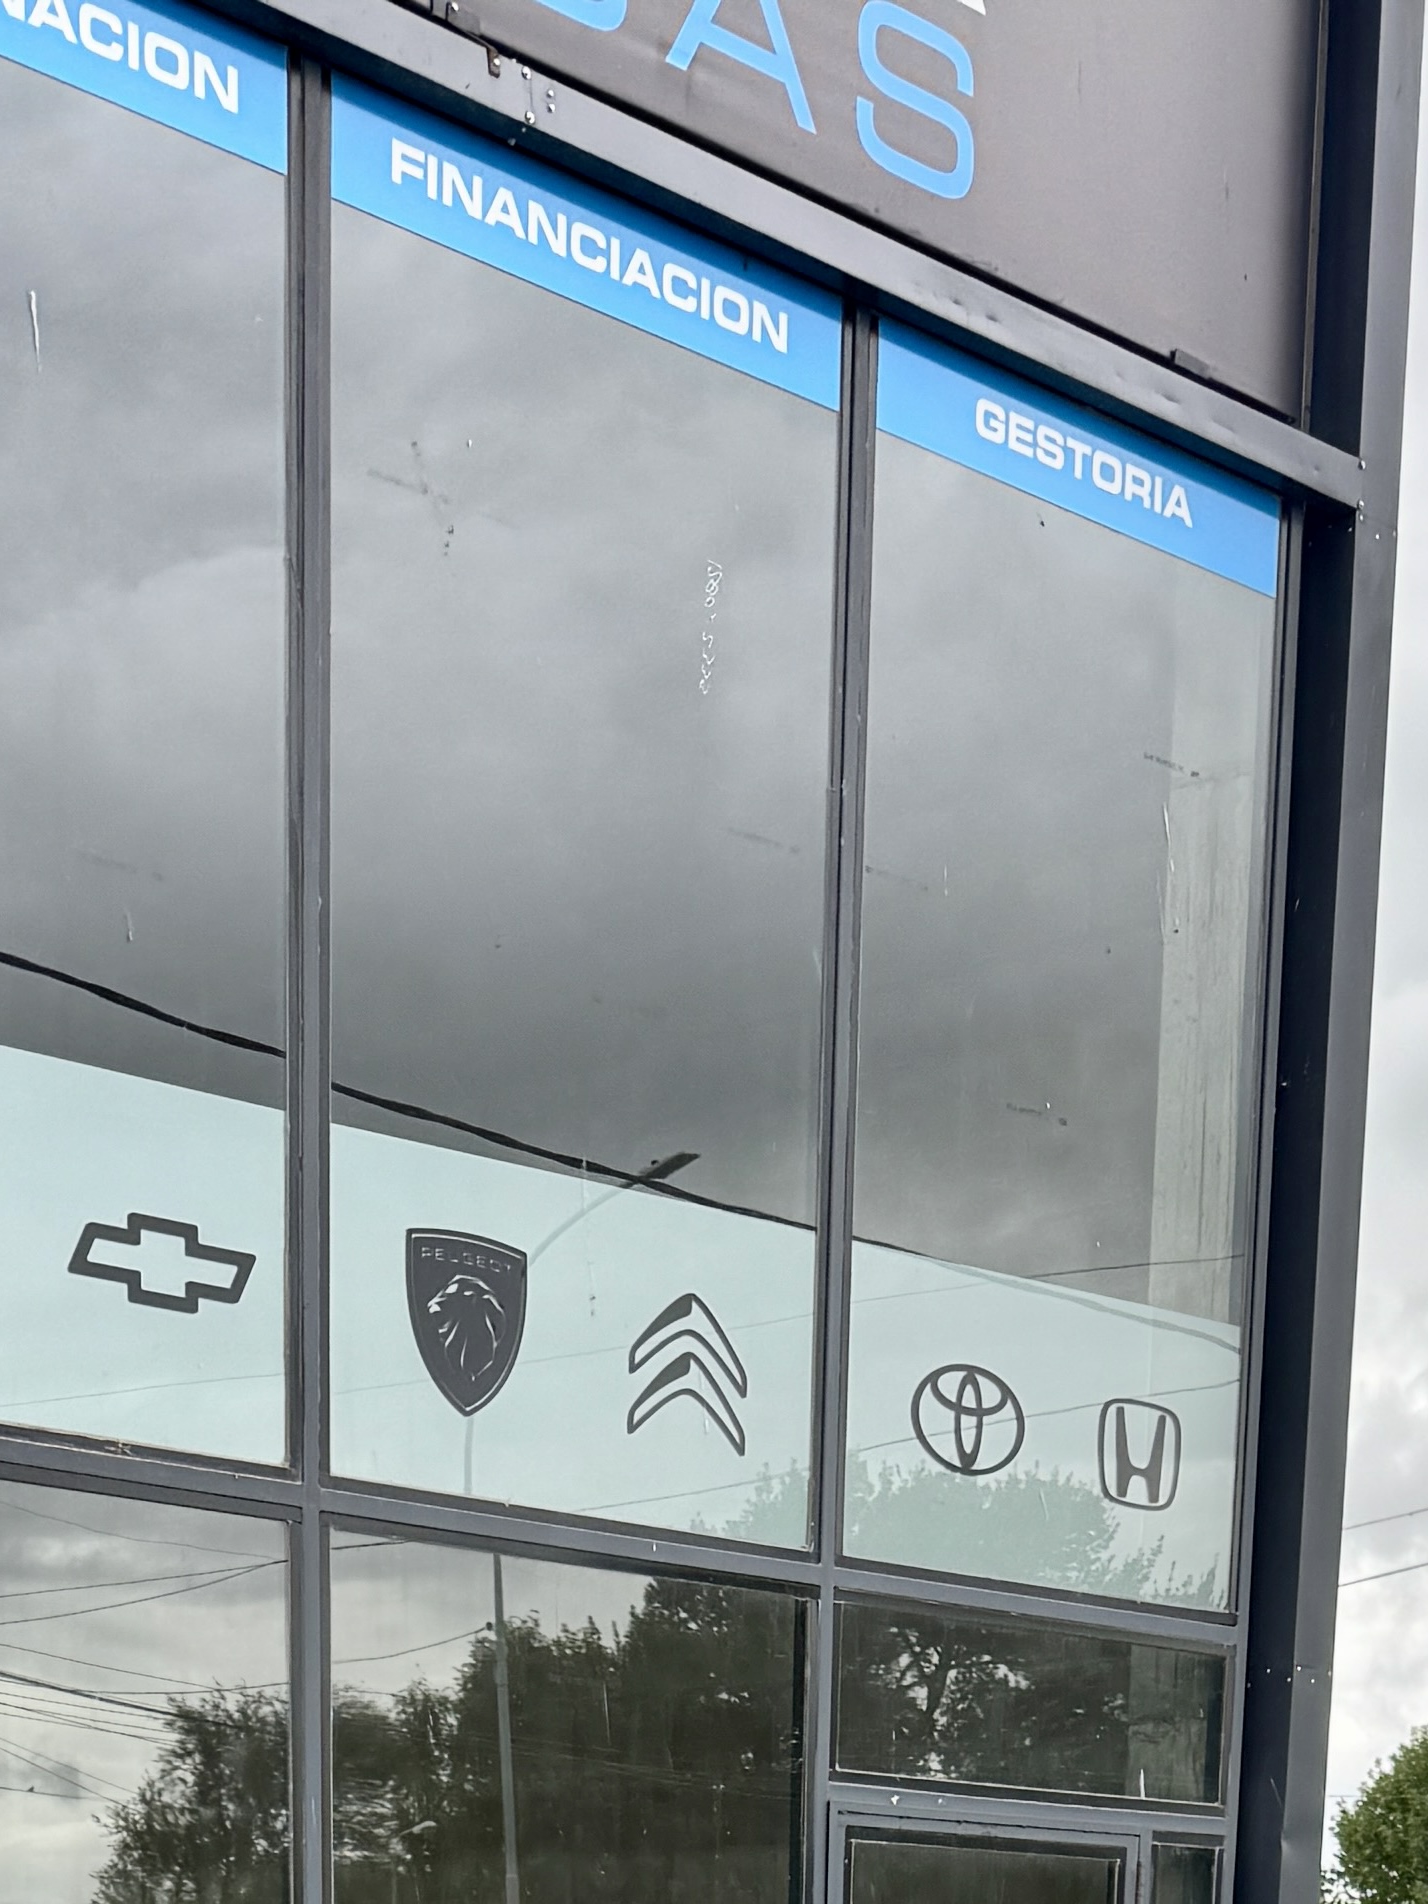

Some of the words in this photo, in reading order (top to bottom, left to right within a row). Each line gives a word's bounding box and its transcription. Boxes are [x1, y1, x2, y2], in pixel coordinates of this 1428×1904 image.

[550, 0, 975, 200] AS
[391, 137, 788, 354] FINANCIACION
[975, 398, 1193, 529] GESTORIA
